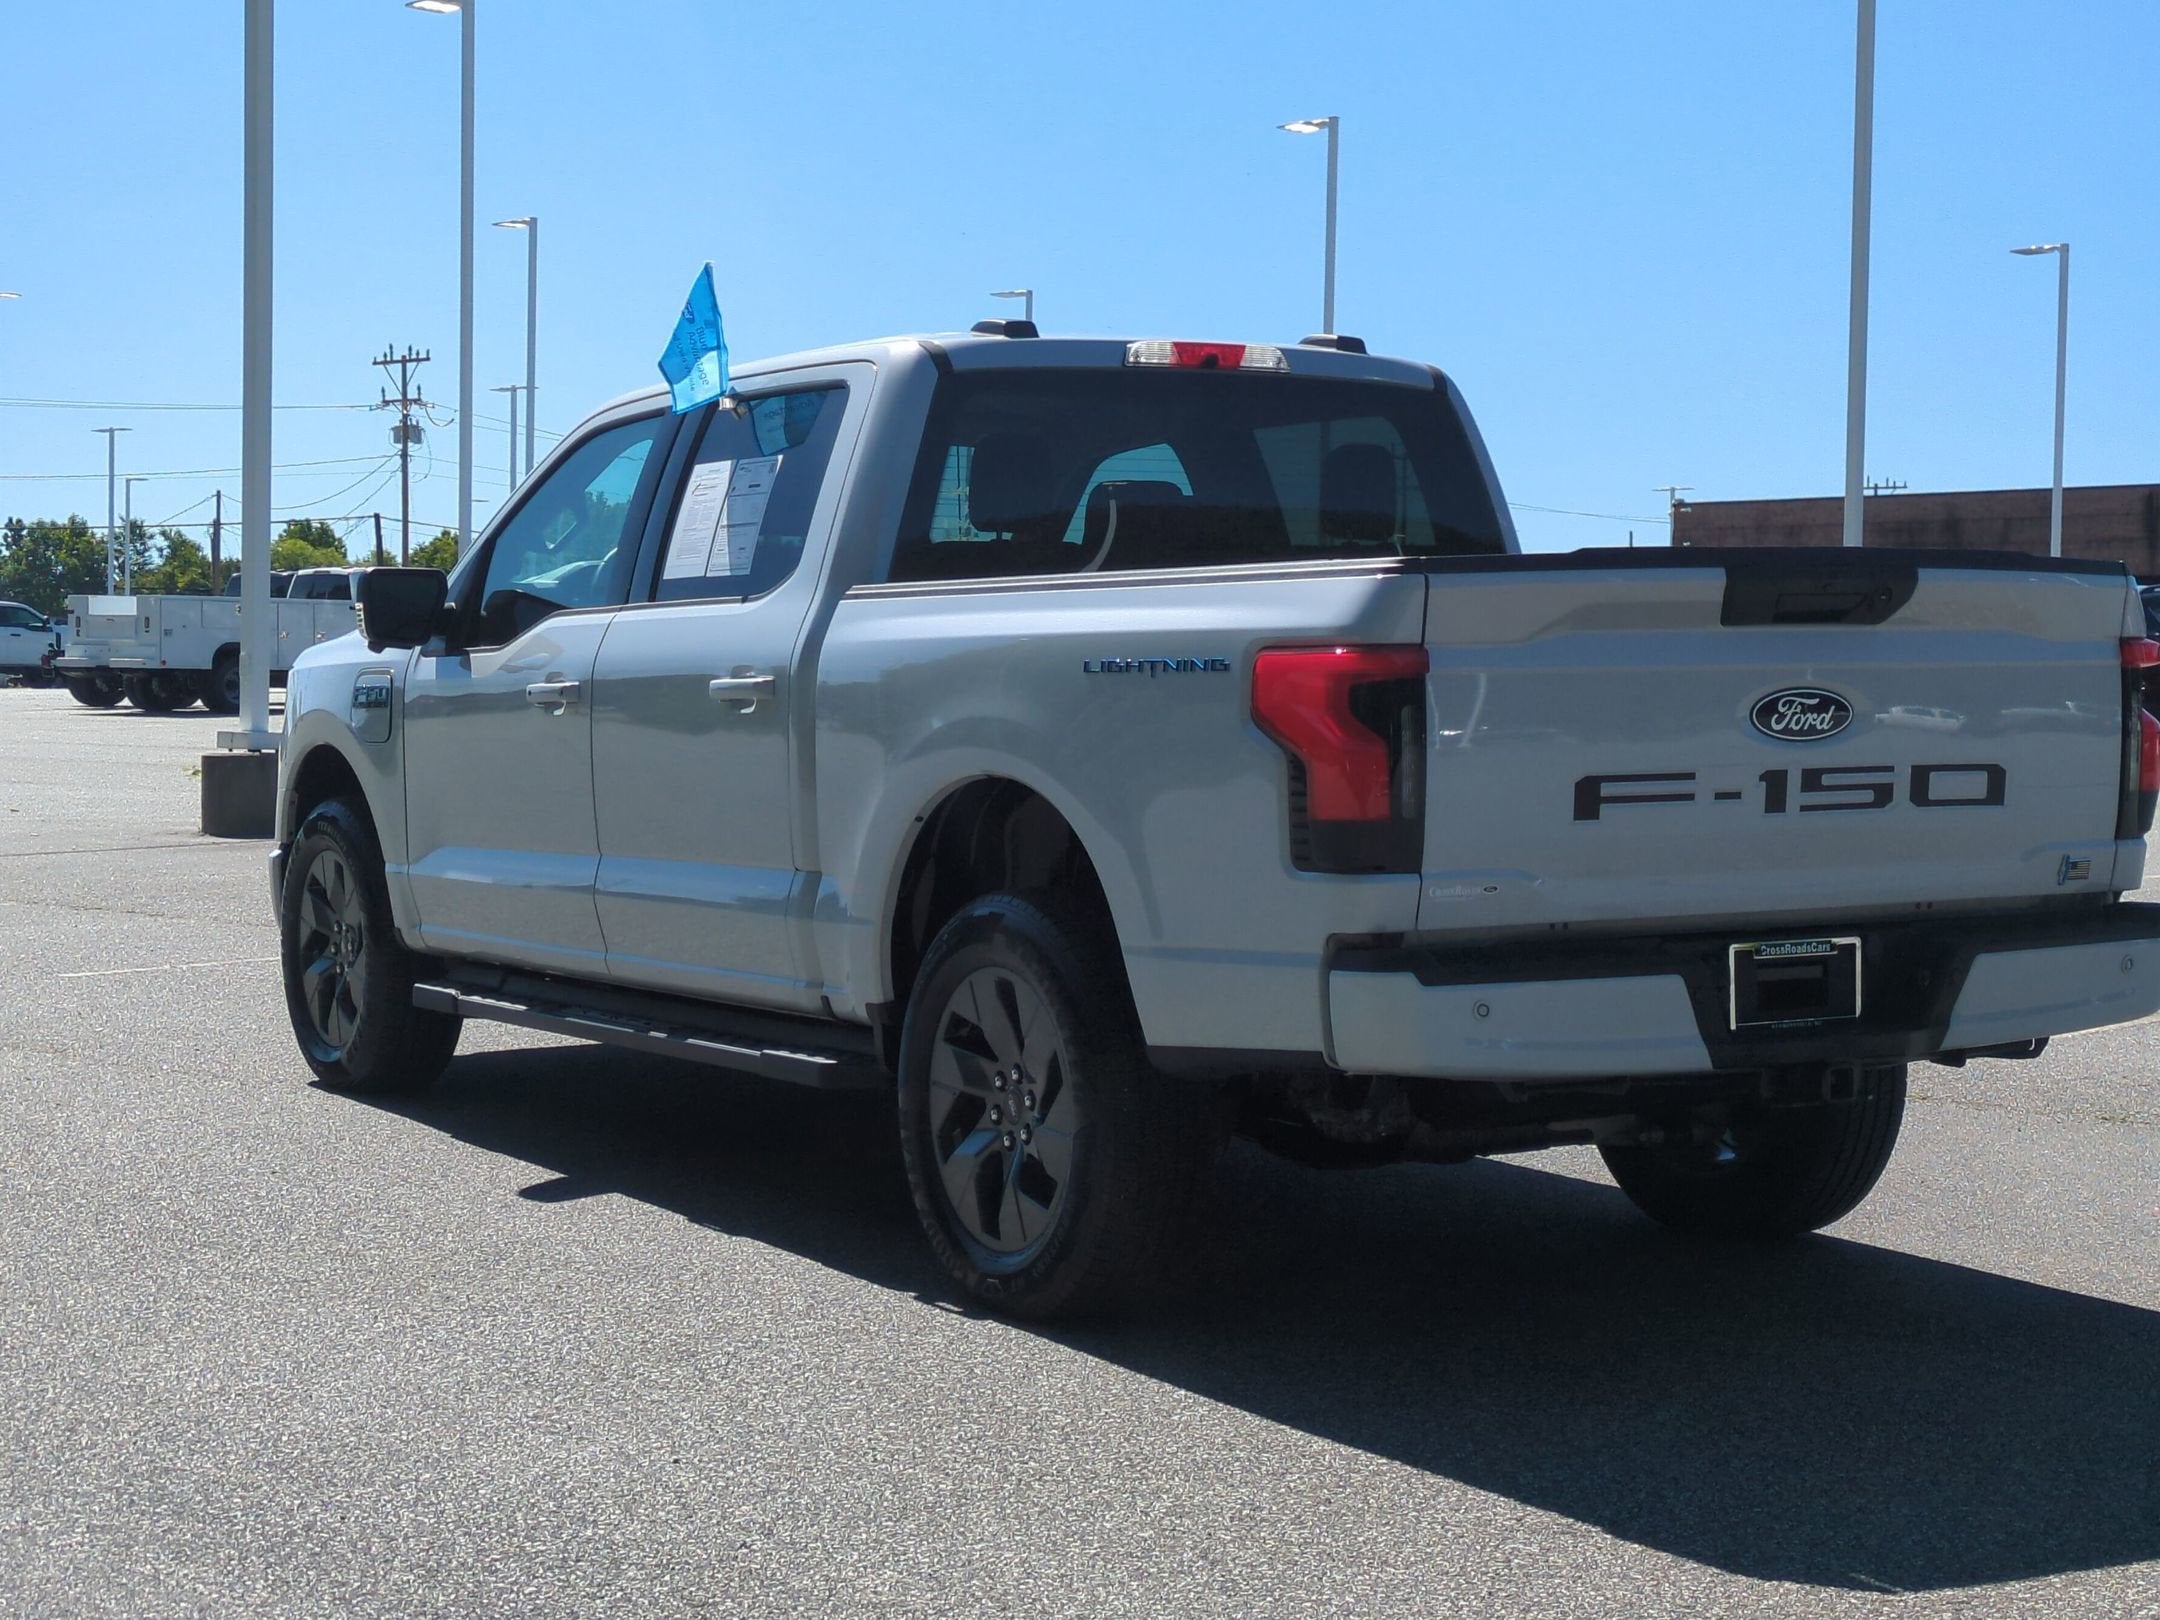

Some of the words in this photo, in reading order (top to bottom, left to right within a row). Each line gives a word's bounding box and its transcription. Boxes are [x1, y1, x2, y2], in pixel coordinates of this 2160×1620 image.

[1083, 657, 1231, 678] LIGHTNING
[1770, 696, 1836, 731] Ford
[1573, 763, 2007, 821] F-150
[1760, 942, 1831, 956] CrossRoadsCars
